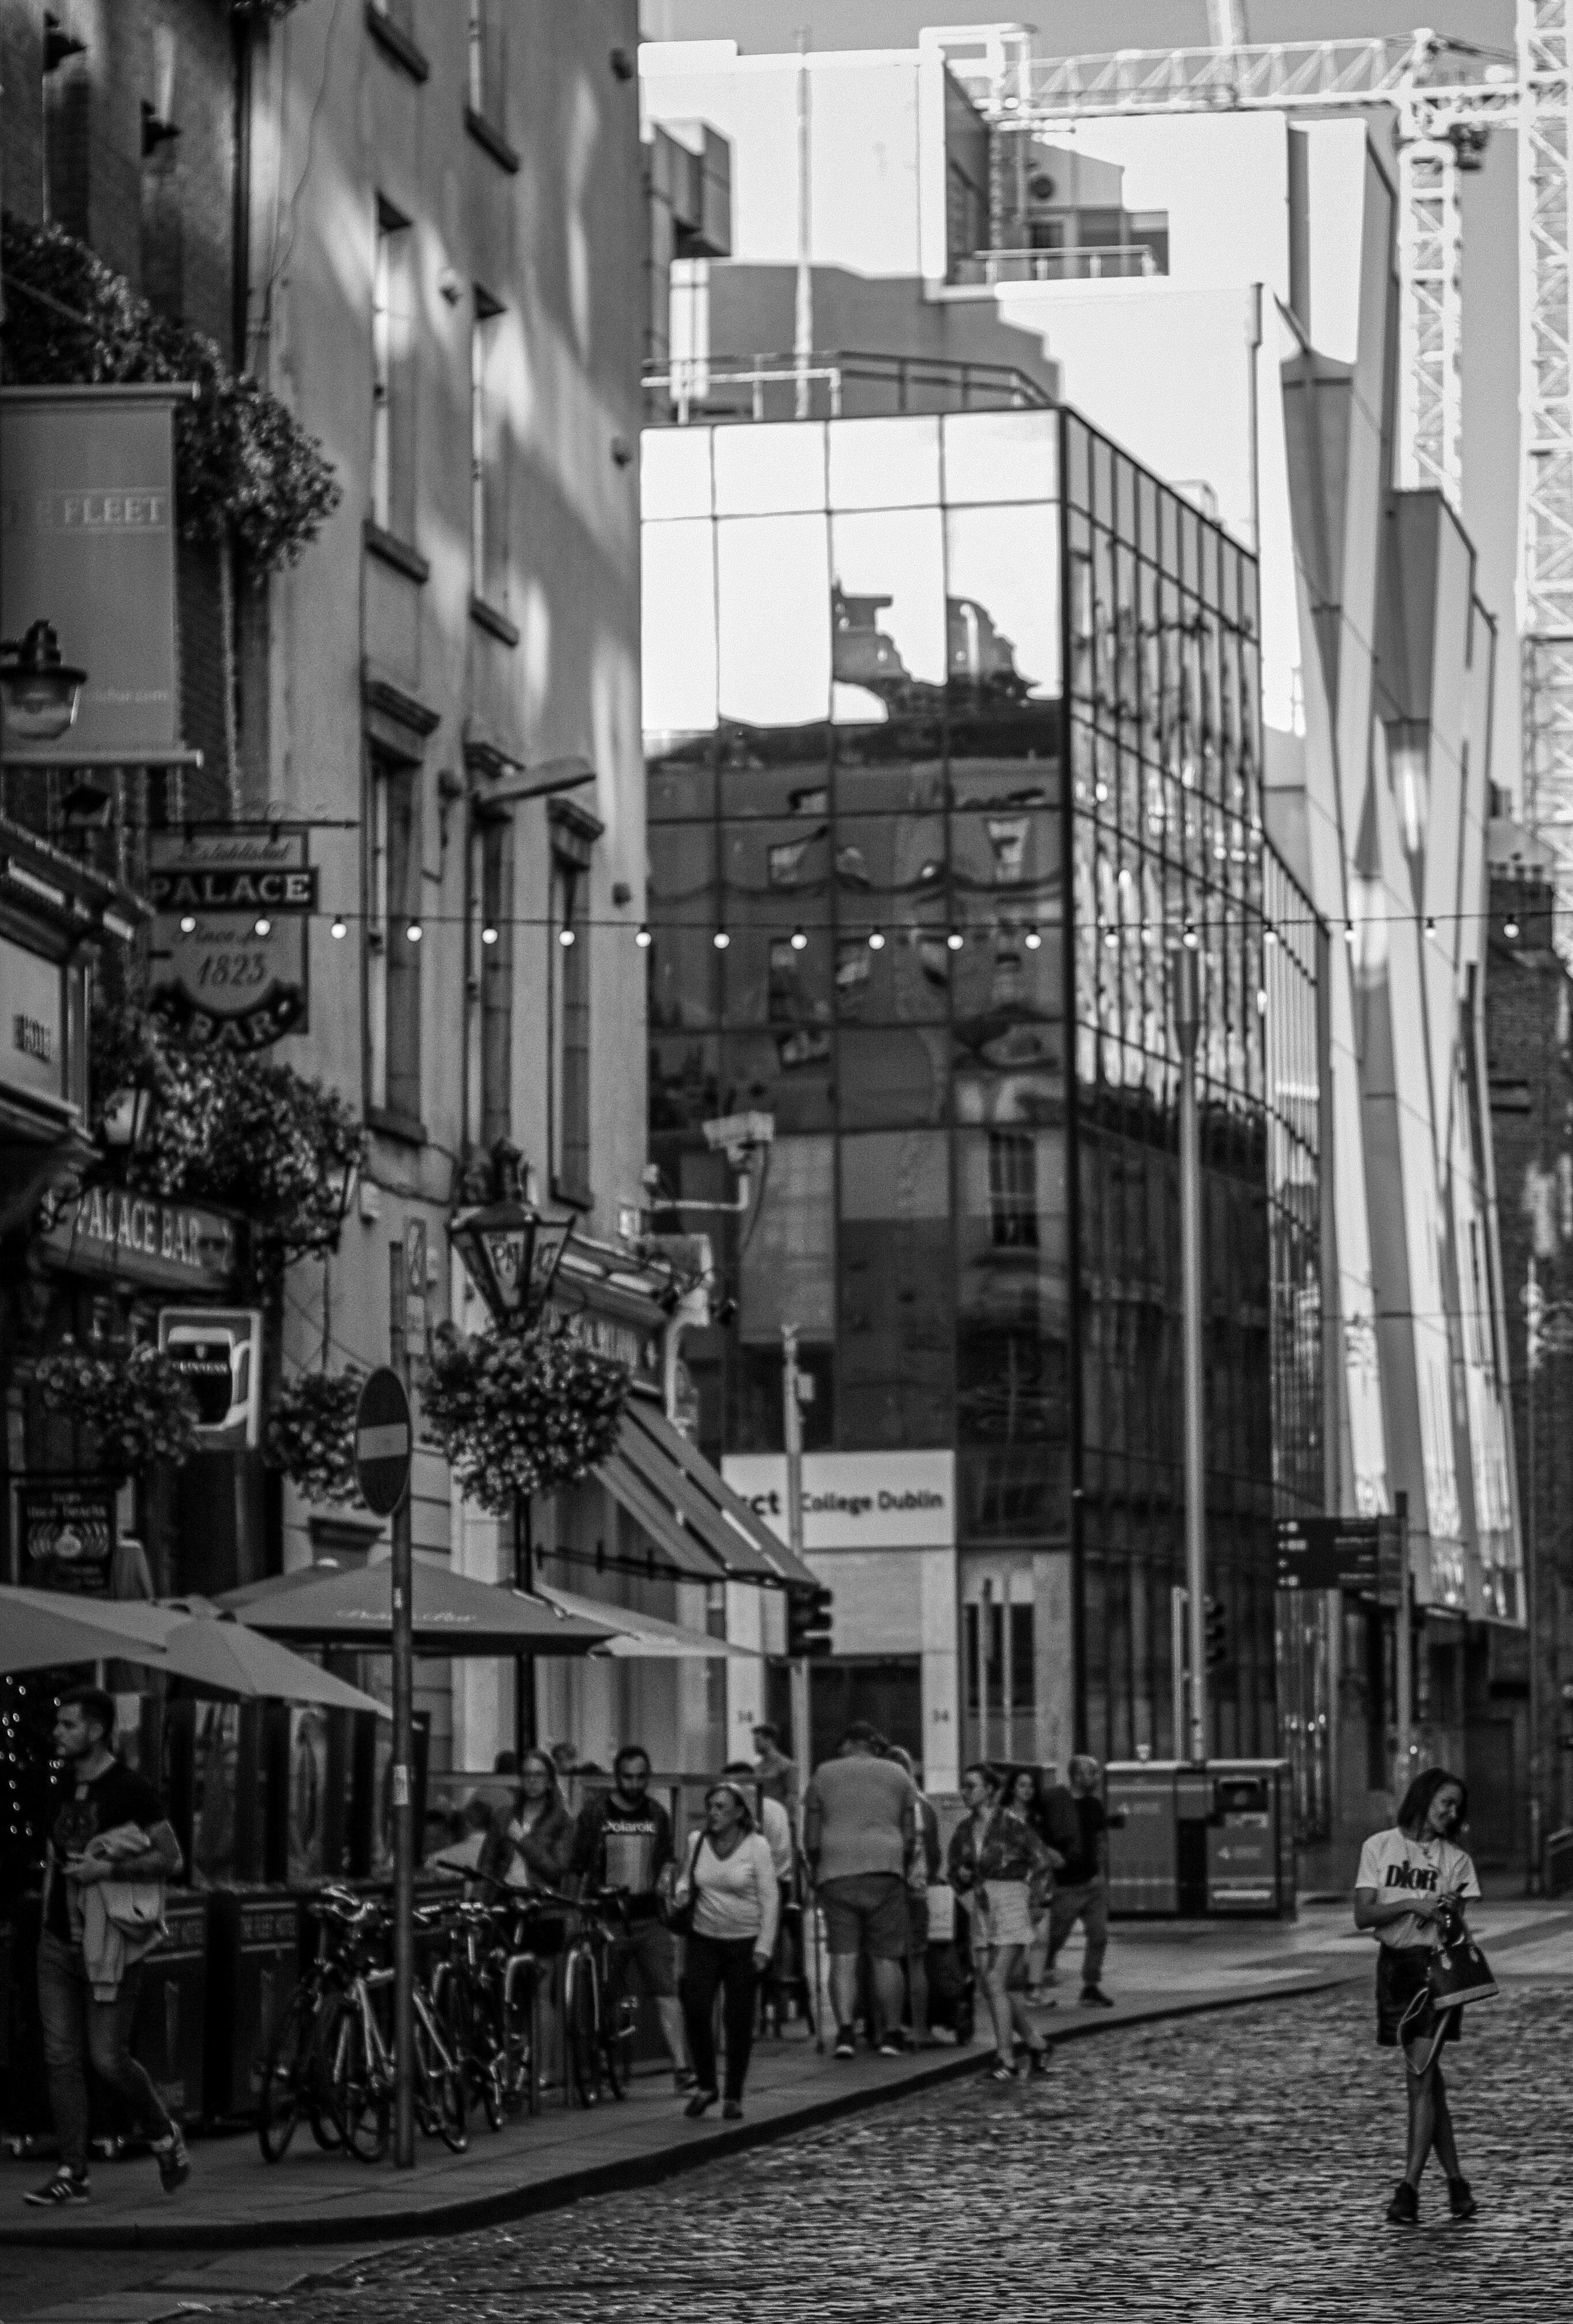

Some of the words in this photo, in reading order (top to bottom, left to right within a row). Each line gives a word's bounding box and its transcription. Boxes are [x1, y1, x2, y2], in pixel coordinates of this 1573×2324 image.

[62, 496, 166, 523] FLEET
[148, 872, 310, 903] PALACE
[189, 1010, 276, 1050] BAR
[77, 1186, 155, 1253] PALACE
[161, 1208, 202, 1266] BAR
[878, 1489, 945, 1512] Dublin
